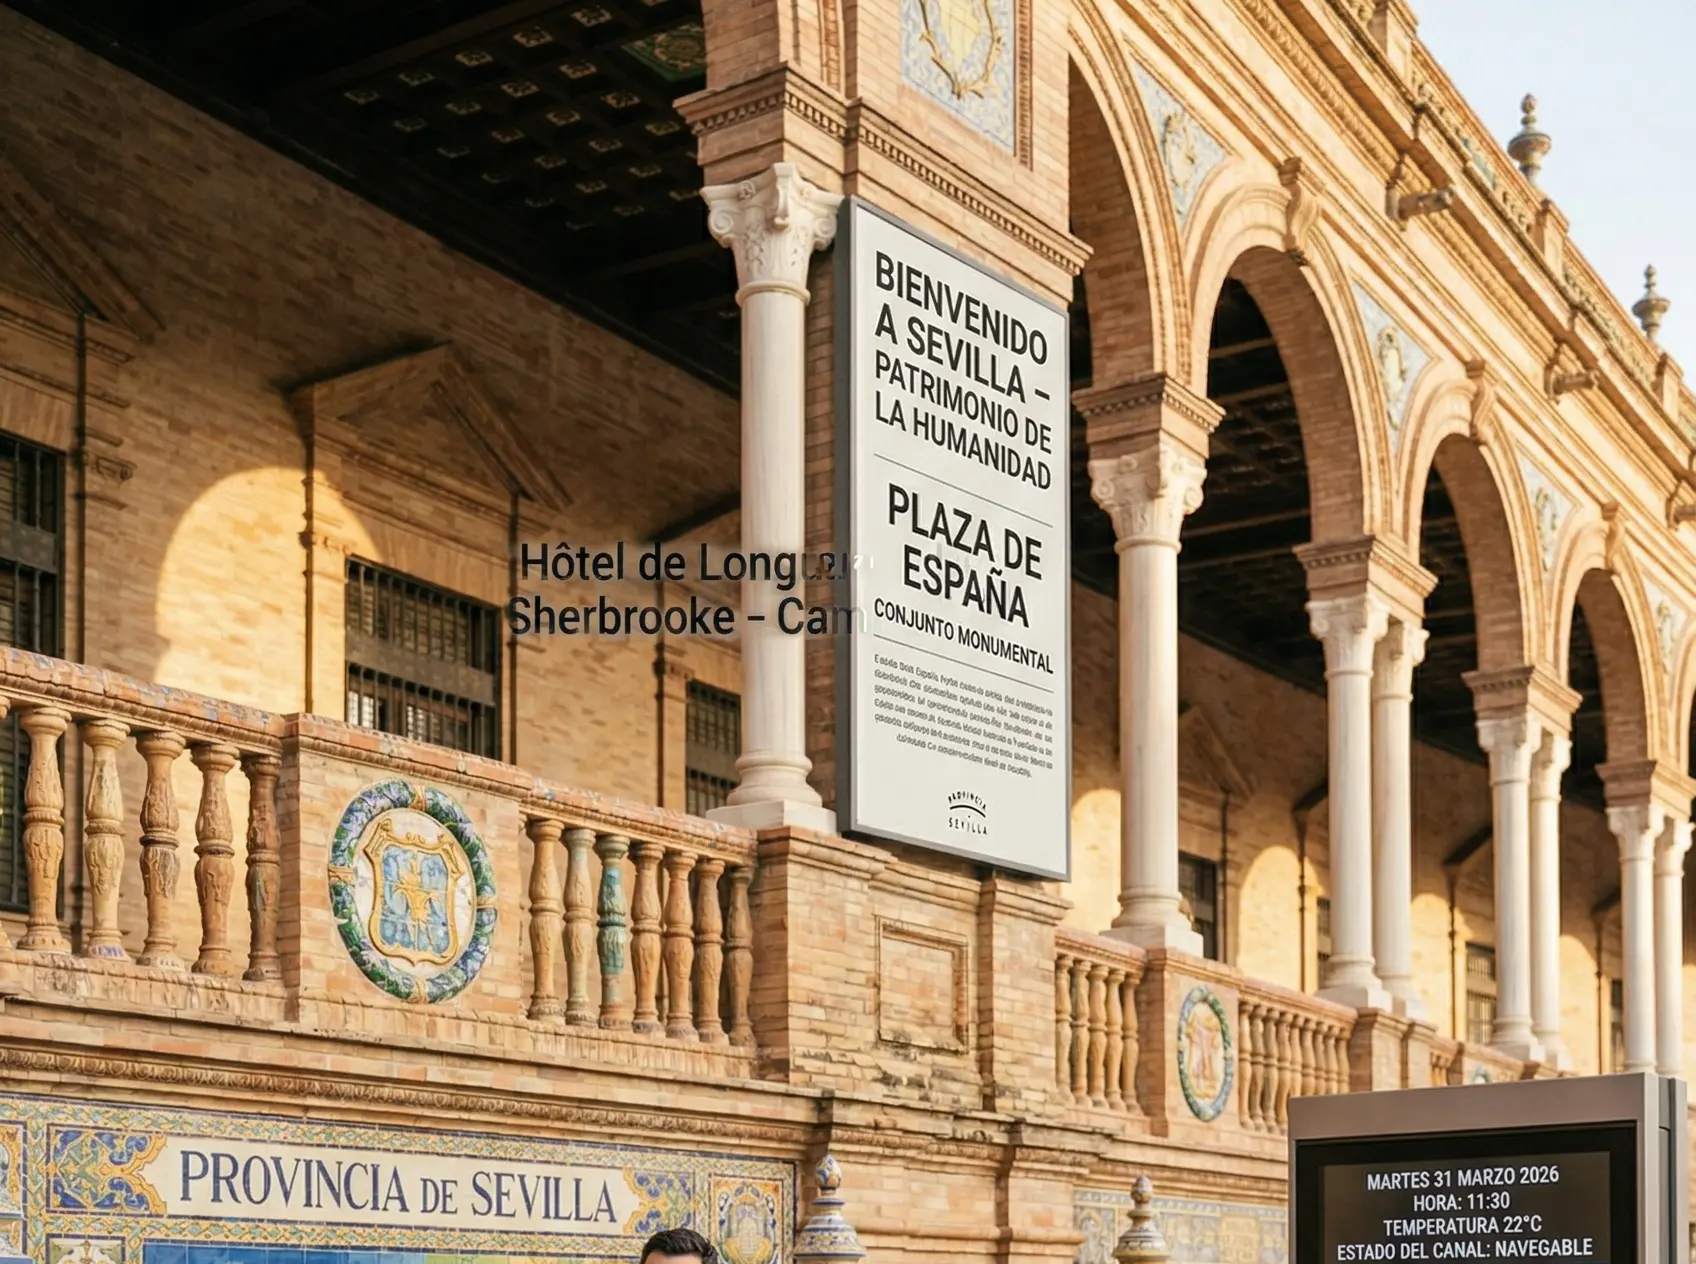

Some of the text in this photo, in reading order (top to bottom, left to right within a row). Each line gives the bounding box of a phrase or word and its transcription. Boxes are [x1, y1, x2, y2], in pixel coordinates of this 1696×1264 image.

[875, 251, 1047, 364] BIENVENIDO
[875, 303, 897, 343] A
[907, 316, 1025, 401] SEVILLA
[875, 350, 1052, 455] PATRIMONIO DE
[875, 391, 1051, 489] LA HUMANIDAD
[888, 483, 1042, 580] PLAZA DE
[904, 544, 1029, 628] ESPAÑA
[874, 598, 1054, 674] CONJUNTO MONUMENTAL
[949, 817, 987, 834] SEVILLA
[180, 1150, 617, 1223] PROVINCIA DE SEVILLA
[1368, 1166, 1559, 1191] MARTES 31 MARZO 2026
[1414, 1192, 1510, 1211] HORA: 11:30
[1338, 1238, 1592, 1261] ESTADO DEL CANAL: NAVEGABLE
[1384, 1215, 1542, 1236] TEMPERATURA 22°C
